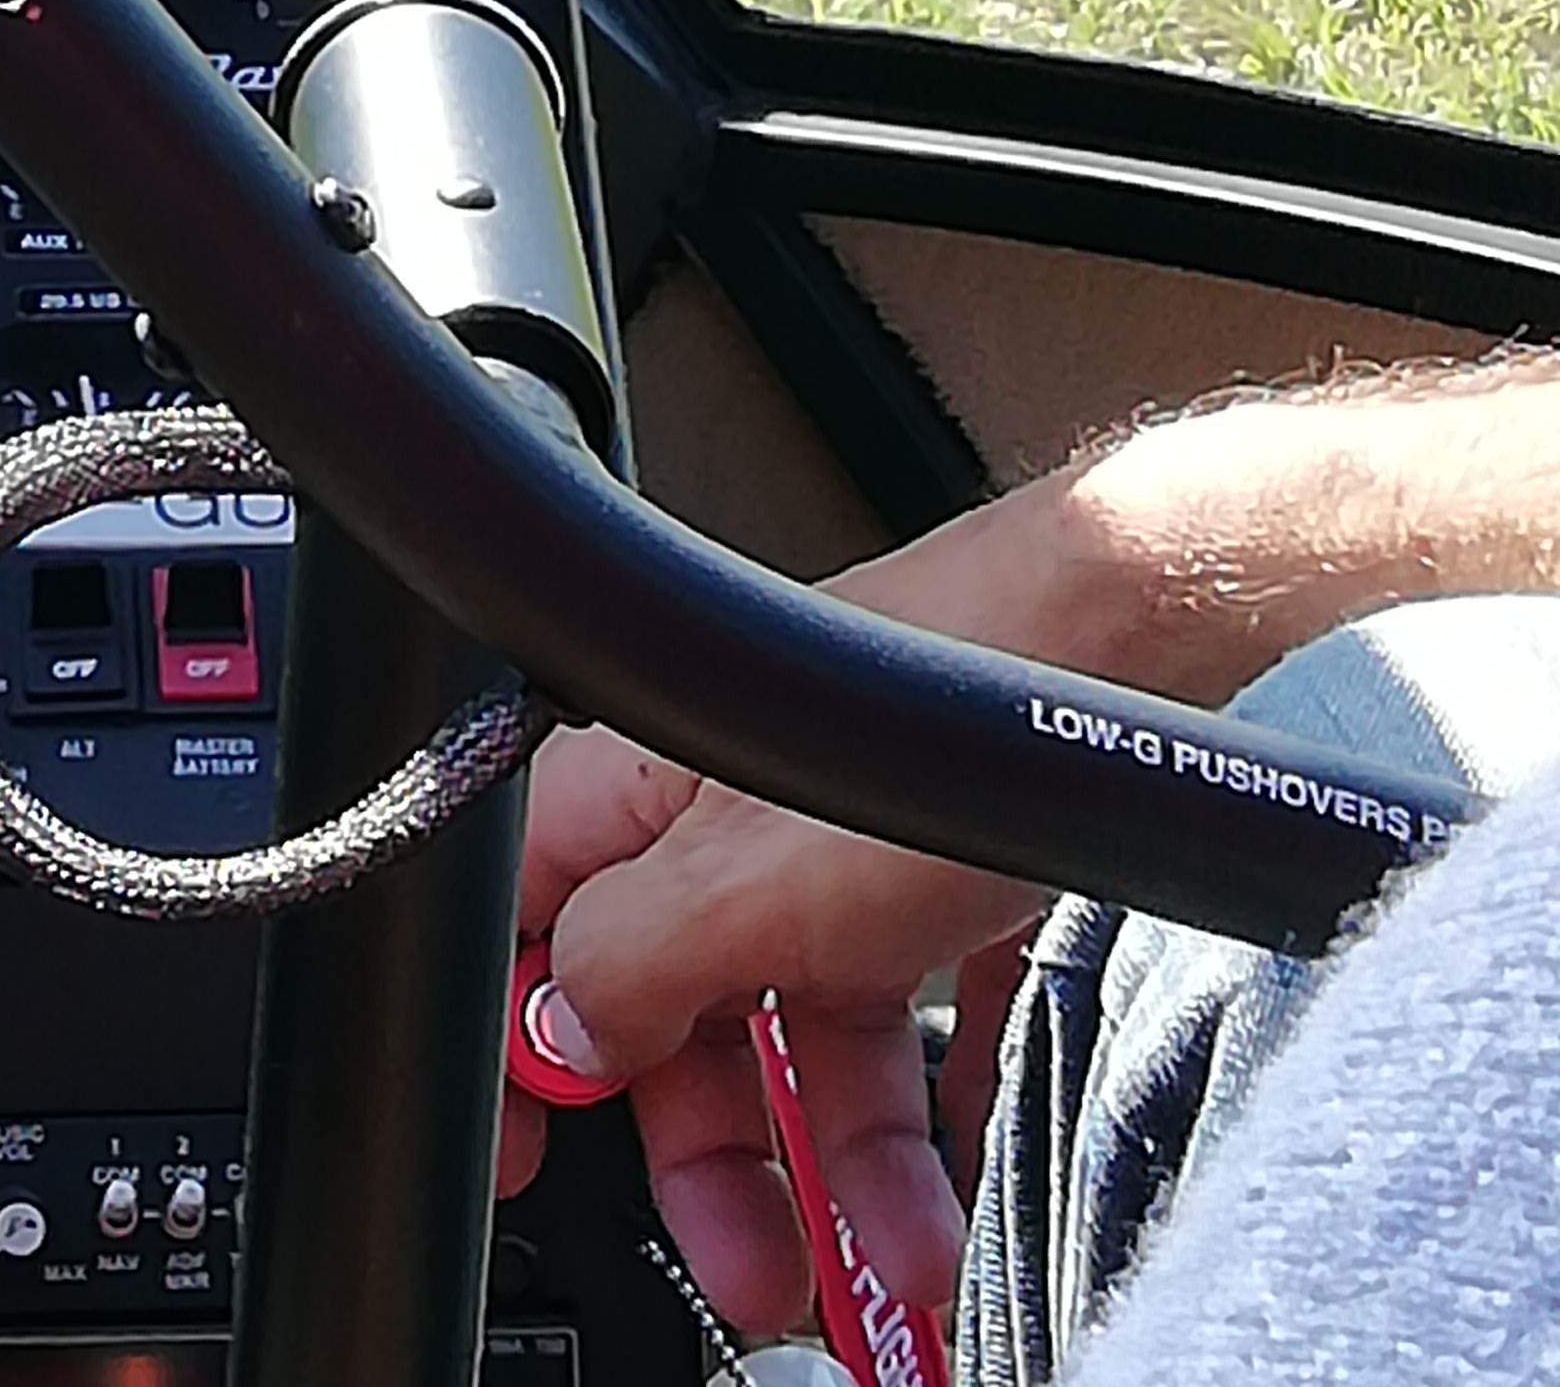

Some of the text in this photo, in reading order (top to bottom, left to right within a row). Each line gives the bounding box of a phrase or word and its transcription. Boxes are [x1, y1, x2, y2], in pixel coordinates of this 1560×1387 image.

[21, 233, 68, 249] AUX
[51, 658, 98, 680] OFF
[185, 658, 230, 678] OFF
[174, 738, 255, 757] MASTER
[1029, 697, 1412, 845] LOW-G PUSHOVERS
[176, 1136, 190, 1156] 2
[44, 1265, 88, 1281] MAX
